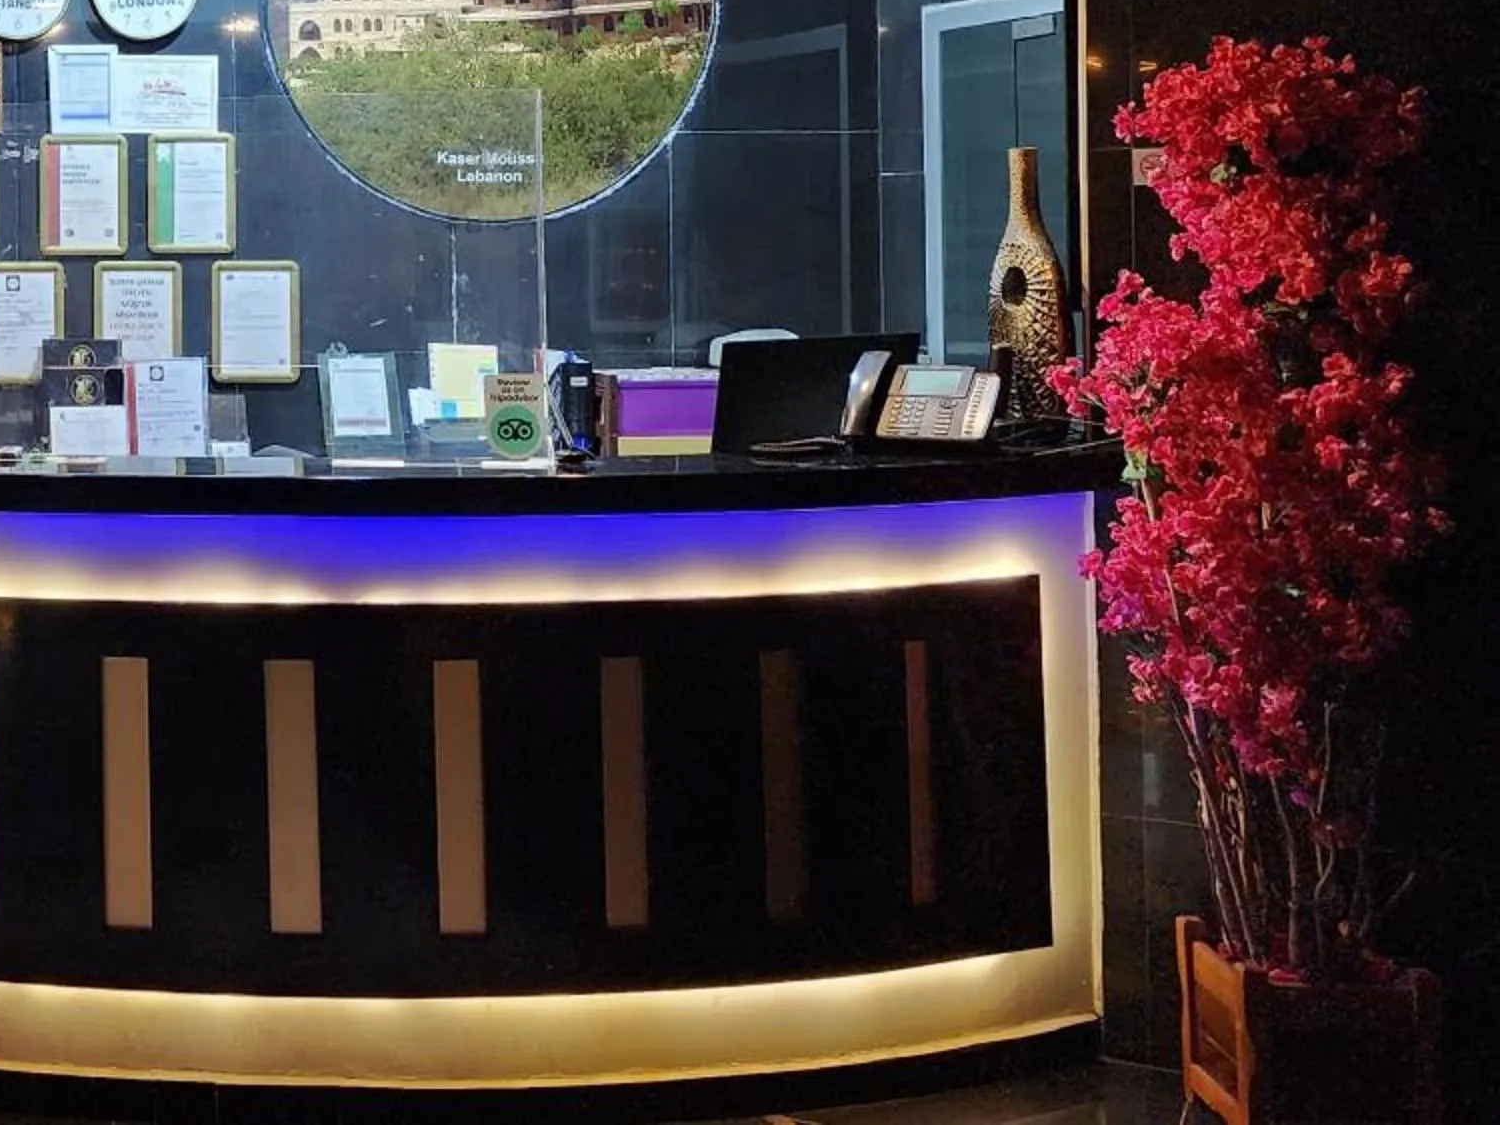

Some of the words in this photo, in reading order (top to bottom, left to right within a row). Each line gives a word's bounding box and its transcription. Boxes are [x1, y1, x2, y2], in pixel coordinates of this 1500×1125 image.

[437, 150, 480, 165] Kaser
[481, 150, 541, 166] Mouss
[457, 169, 522, 183] Lebanon
